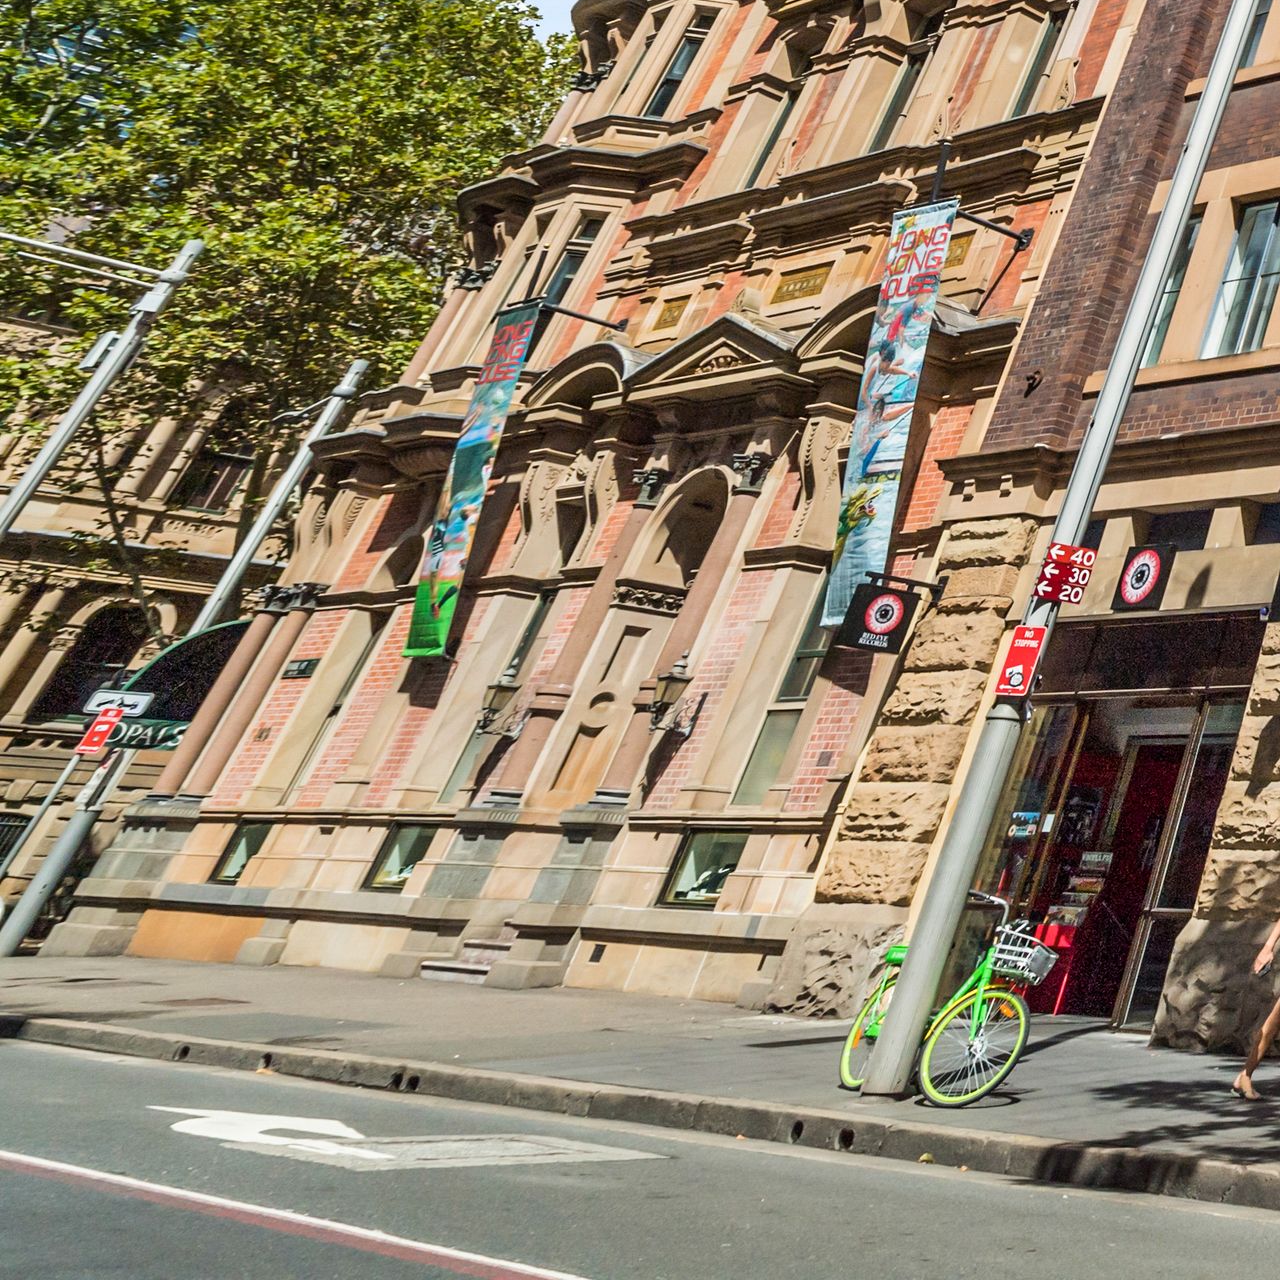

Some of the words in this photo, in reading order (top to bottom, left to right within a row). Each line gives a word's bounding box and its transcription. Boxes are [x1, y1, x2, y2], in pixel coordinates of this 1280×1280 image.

[494, 320, 533, 343] ONG
[1070, 550, 1095, 566] 40
[1068, 568, 1090, 585] 30
[1058, 585, 1083, 602] 20
[1014, 639, 1039, 648] STOPPING
